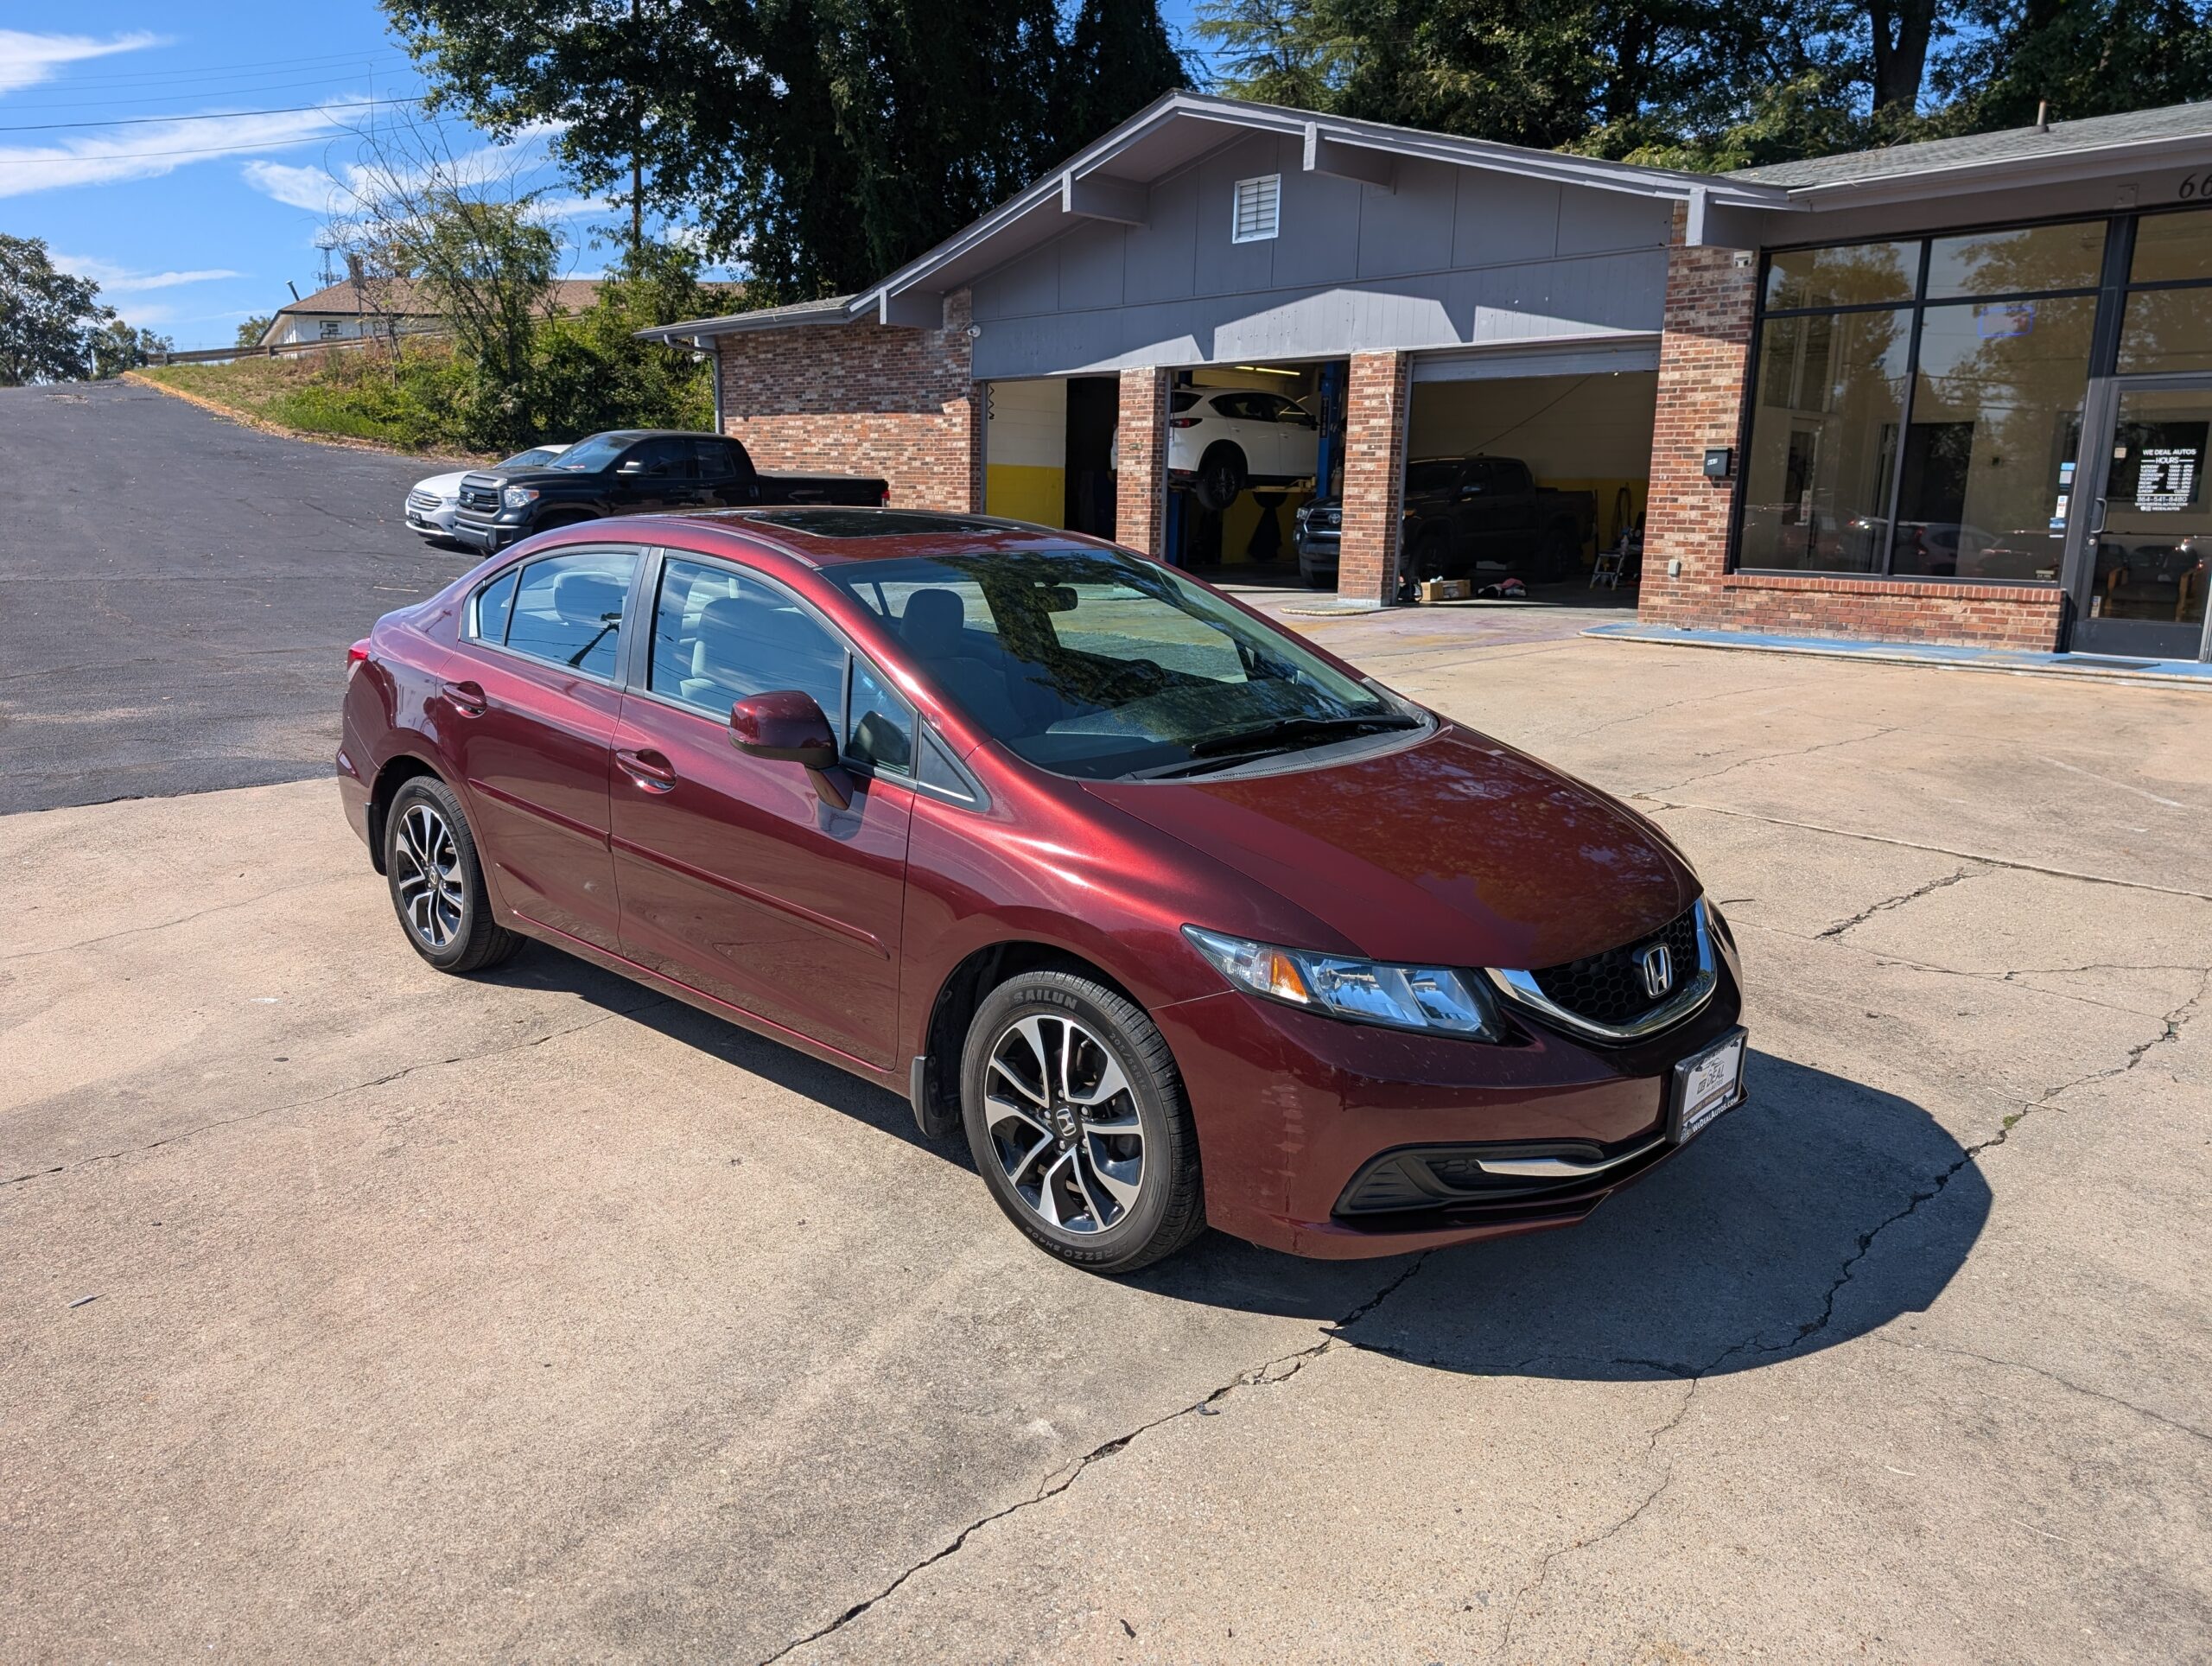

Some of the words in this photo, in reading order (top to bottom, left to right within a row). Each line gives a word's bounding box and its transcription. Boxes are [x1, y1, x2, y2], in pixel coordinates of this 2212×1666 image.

[1014, 989, 1077, 1009] SAILUN
[1109, 1033, 1147, 1091] 205/55R16
[1707, 1064, 1725, 1087] DEAL
